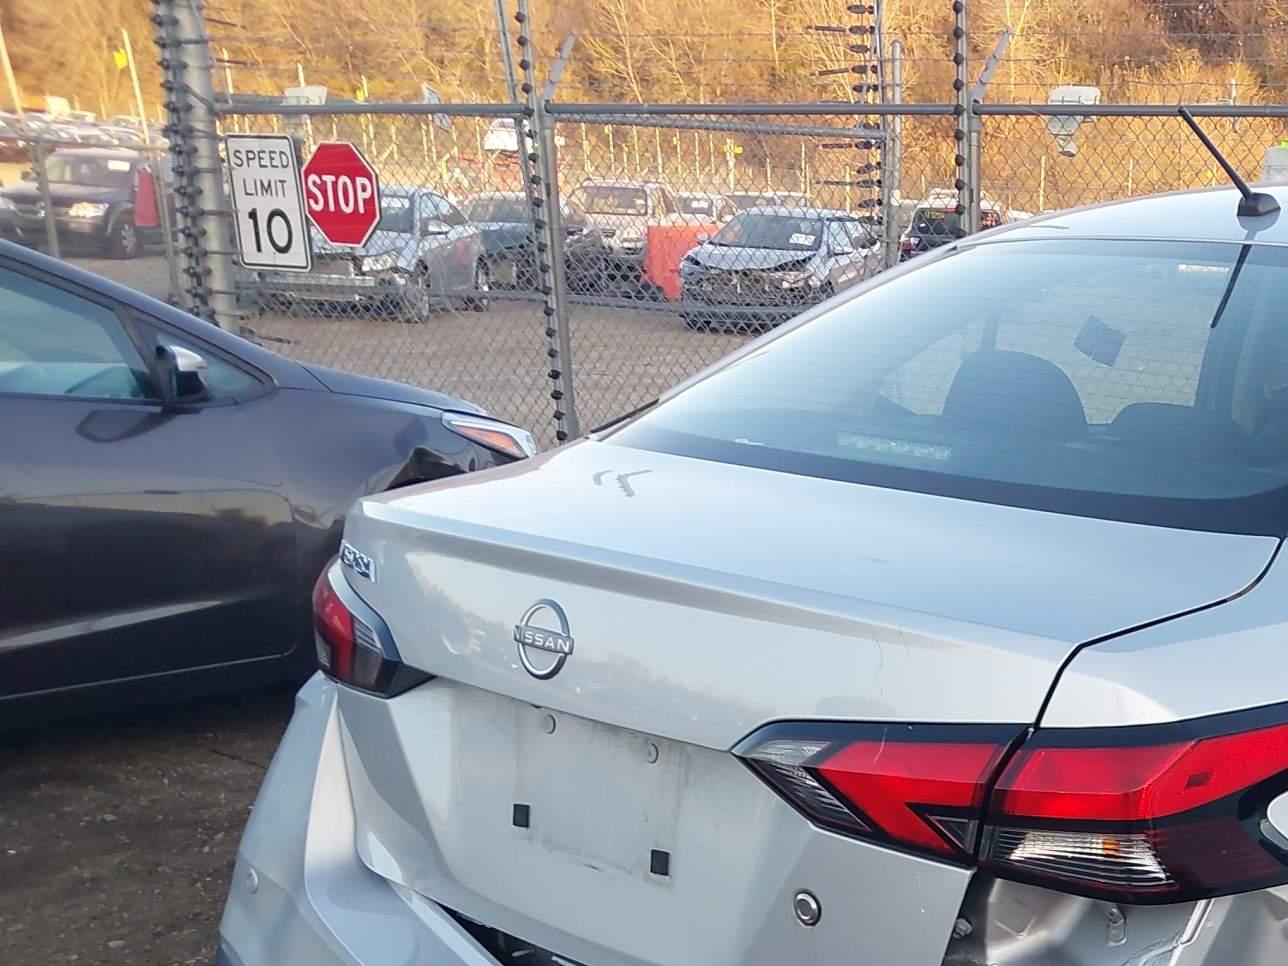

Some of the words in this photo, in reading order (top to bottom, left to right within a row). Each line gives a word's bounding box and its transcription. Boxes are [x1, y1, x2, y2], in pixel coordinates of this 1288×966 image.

[233, 150, 290, 168] SPEED
[243, 178, 288, 197] LIMIT
[307, 173, 373, 214] STOP
[248, 207, 293, 254] 10
[513, 626, 570, 653] NISSAN
